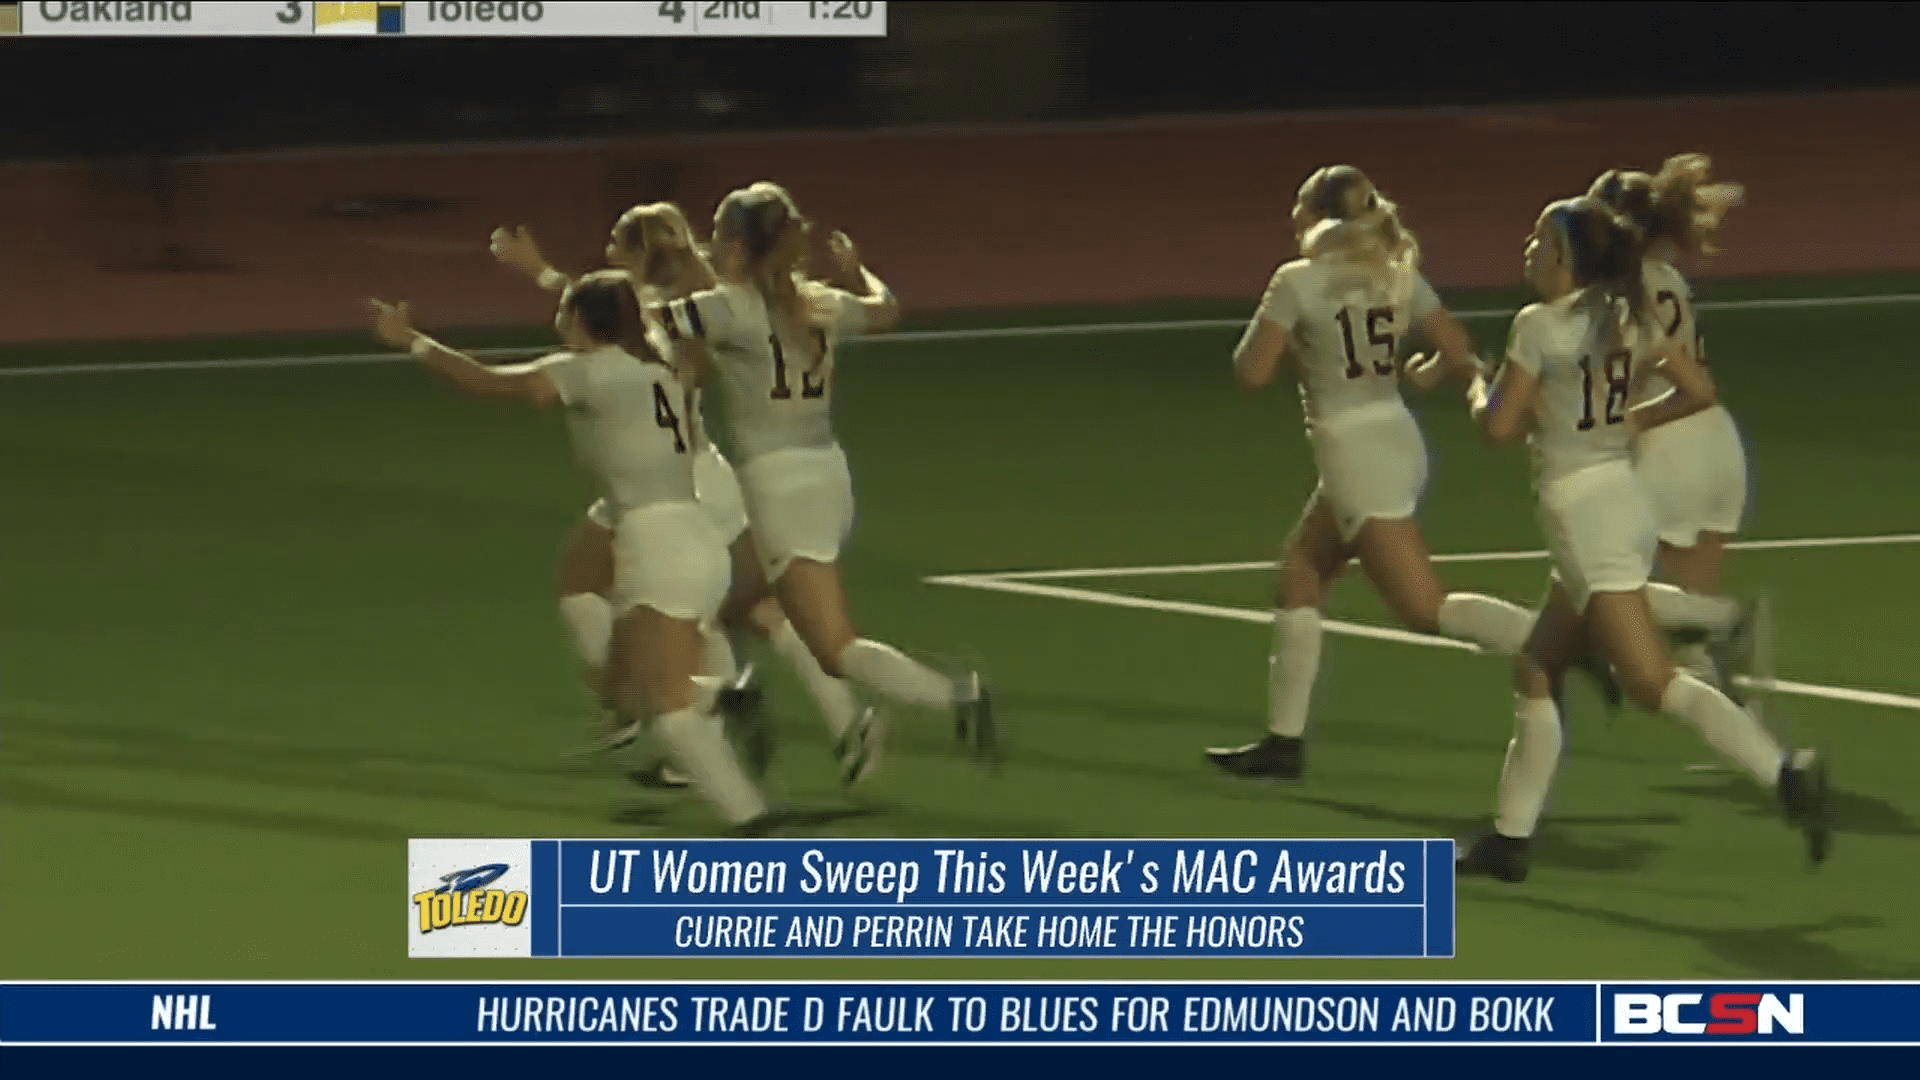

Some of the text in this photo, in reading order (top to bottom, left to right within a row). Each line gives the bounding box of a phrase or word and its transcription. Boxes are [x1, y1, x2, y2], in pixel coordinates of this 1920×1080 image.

[1335, 306, 1396, 379] 15
[653, 382, 687, 454] 4
[1577, 351, 1632, 431] 18
